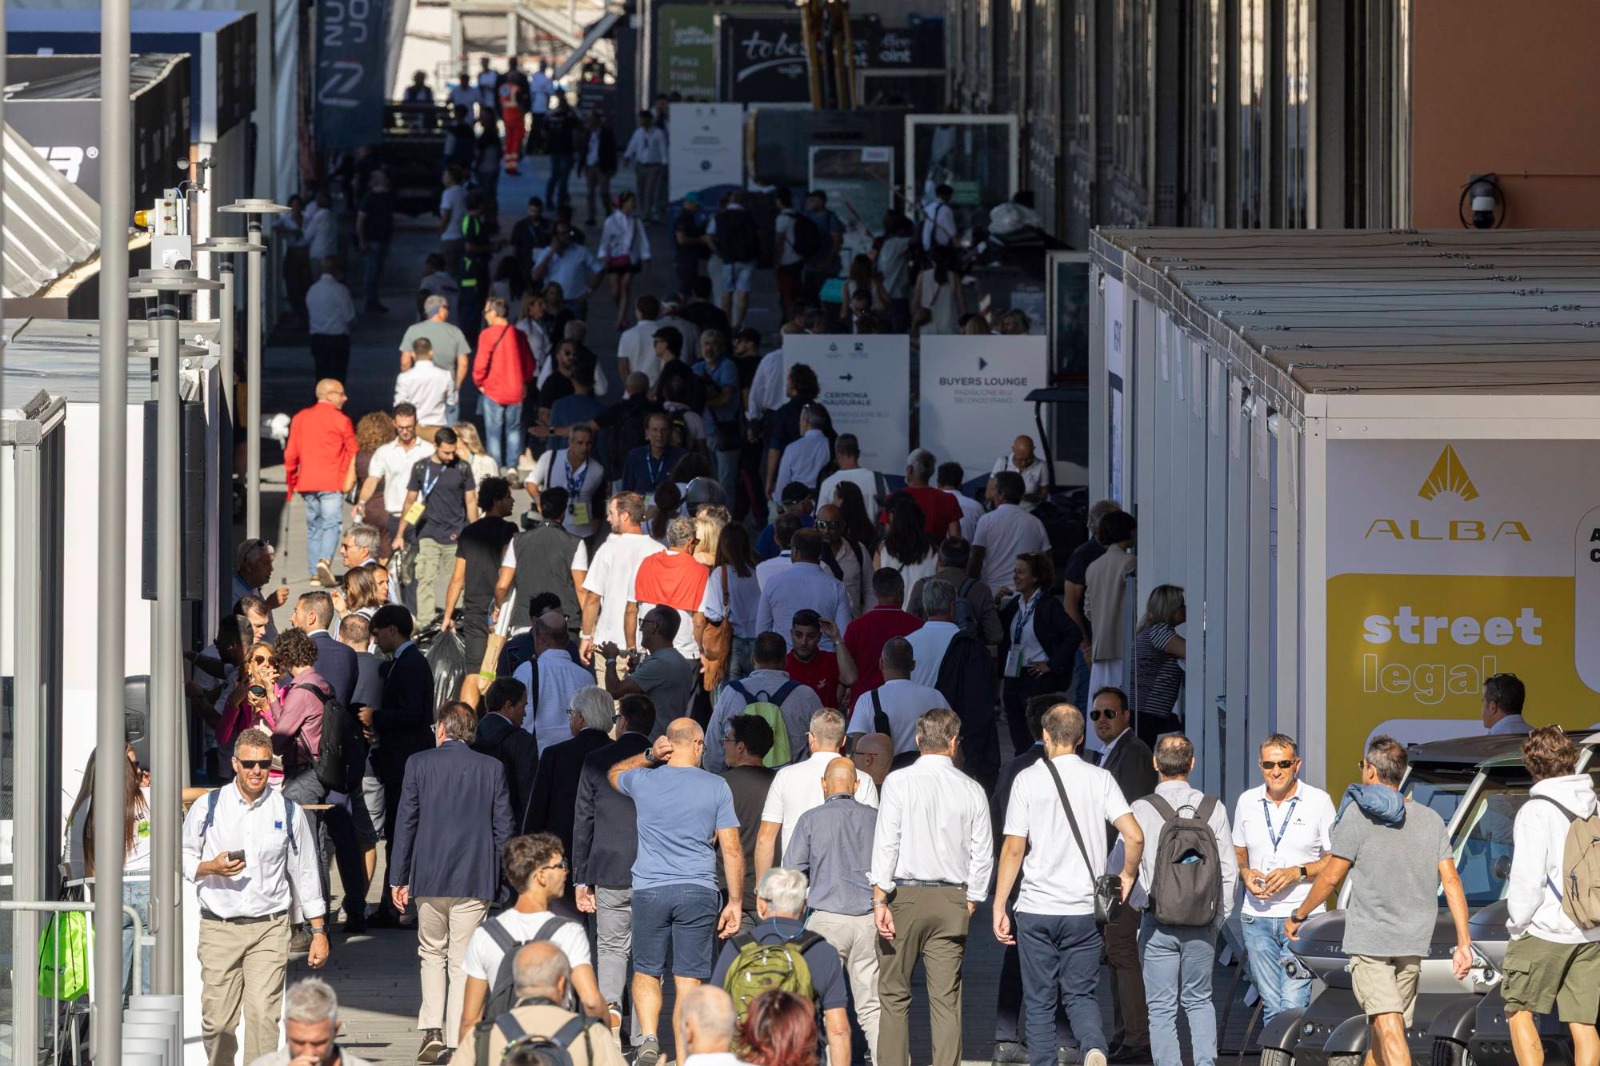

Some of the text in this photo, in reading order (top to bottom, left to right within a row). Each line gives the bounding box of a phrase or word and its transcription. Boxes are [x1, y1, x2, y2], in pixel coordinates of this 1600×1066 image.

[939, 376, 1029, 386] BUYERS LOUNGE
[824, 391, 869, 399] CERIMONIA
[1364, 519, 1532, 542] ALBA
[1362, 606, 1543, 646] street
[1362, 653, 1498, 706] legal
